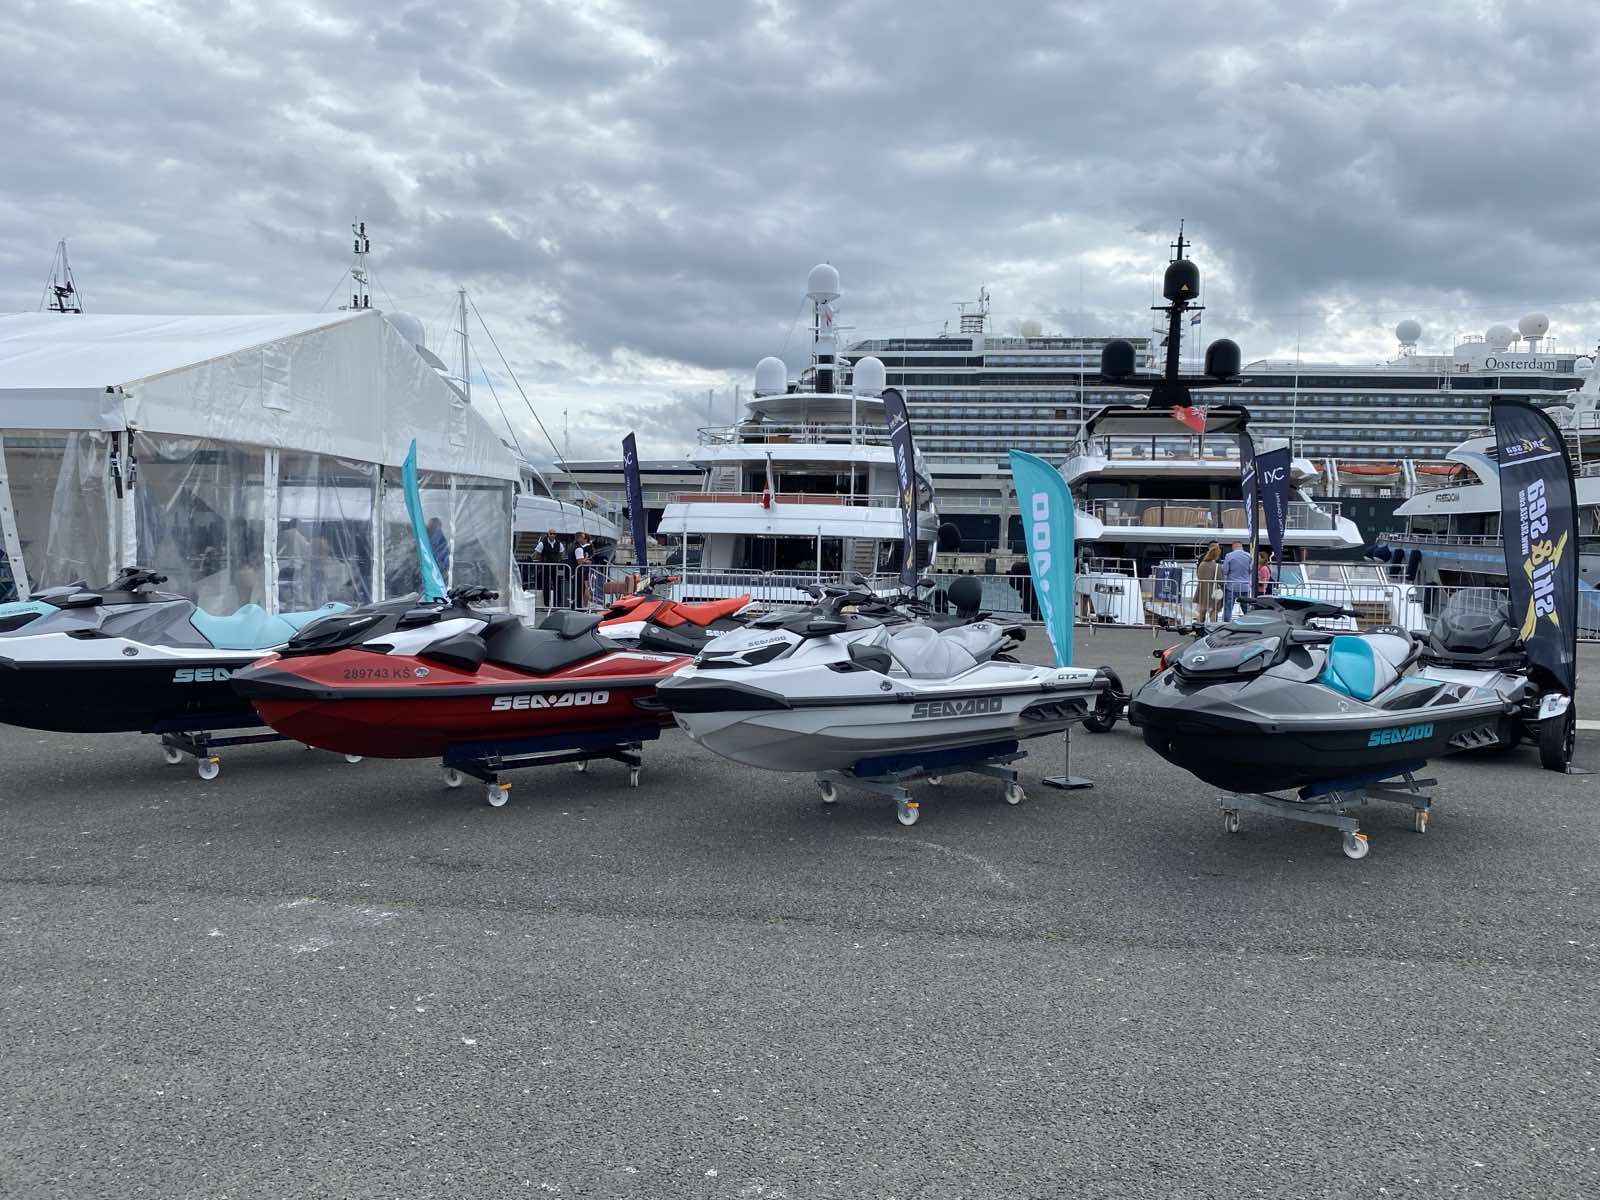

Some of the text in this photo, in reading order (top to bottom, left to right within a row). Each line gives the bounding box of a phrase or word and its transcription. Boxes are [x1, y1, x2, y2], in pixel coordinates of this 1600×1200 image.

[1485, 357, 1555, 370] Oosterdam
[1263, 467, 1285, 484] IYC
[343, 668, 389, 679] 289743
